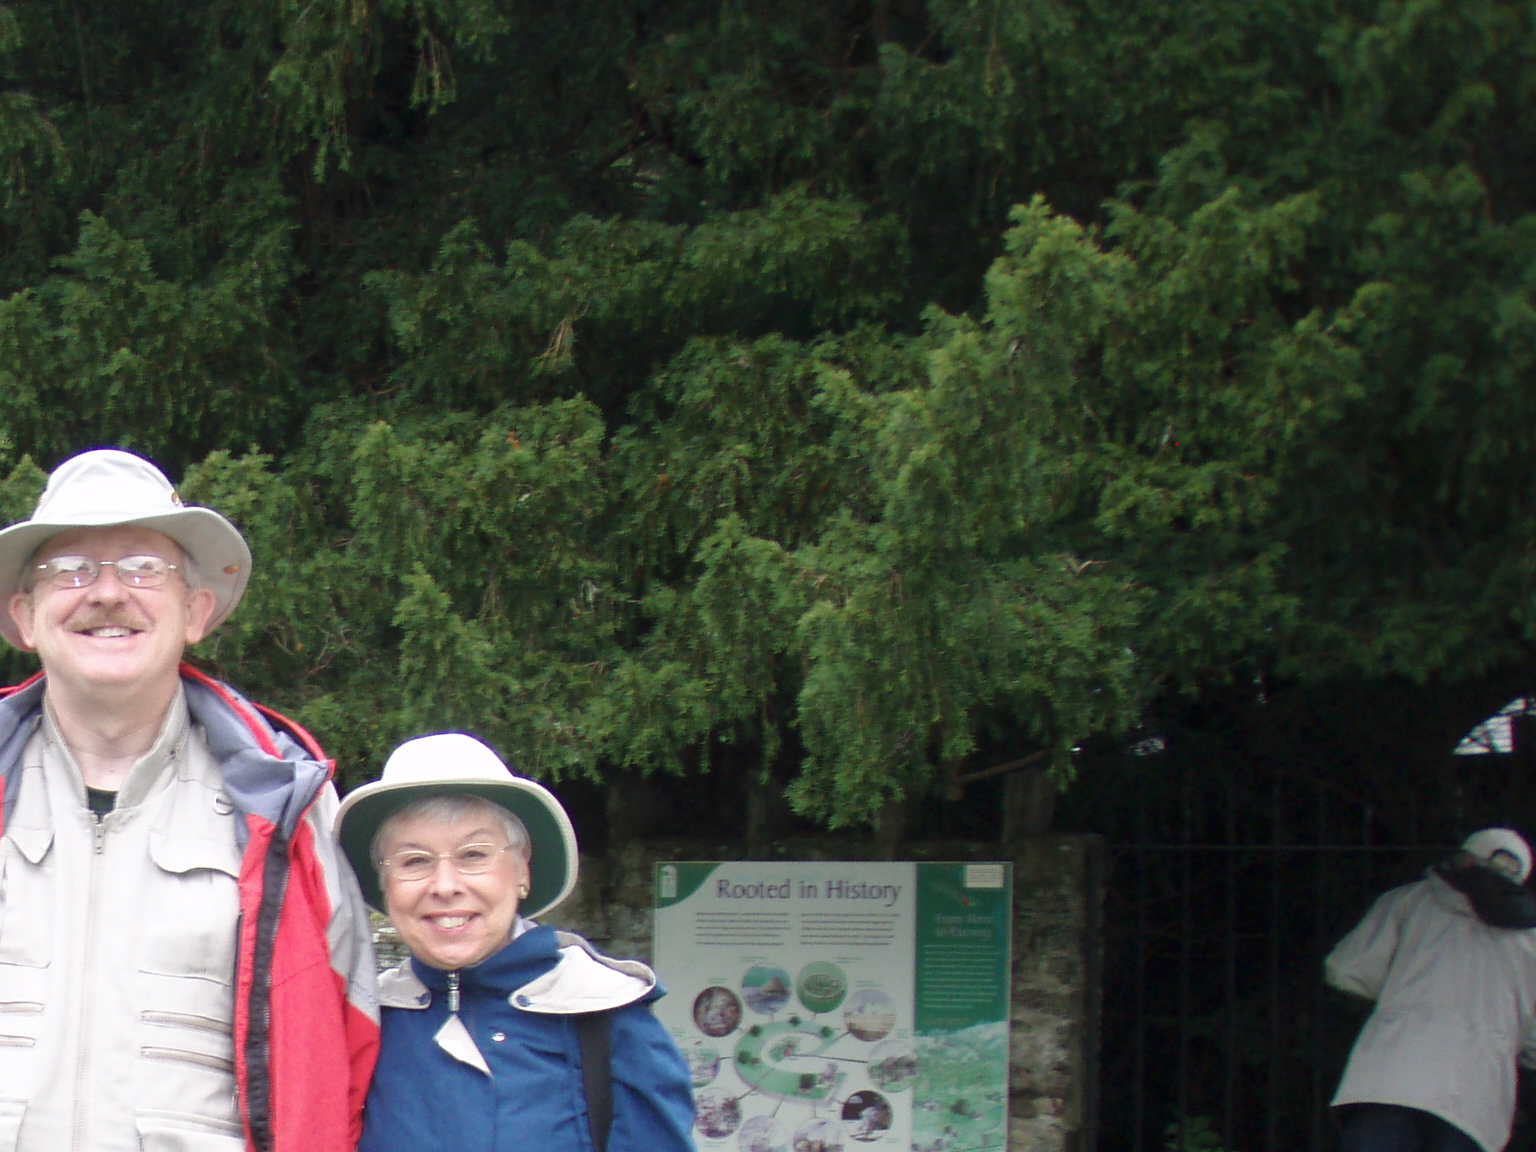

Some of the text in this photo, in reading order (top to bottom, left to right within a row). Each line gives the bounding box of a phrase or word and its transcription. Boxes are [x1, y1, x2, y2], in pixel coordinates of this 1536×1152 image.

[716, 878, 902, 908] Rooted in History
